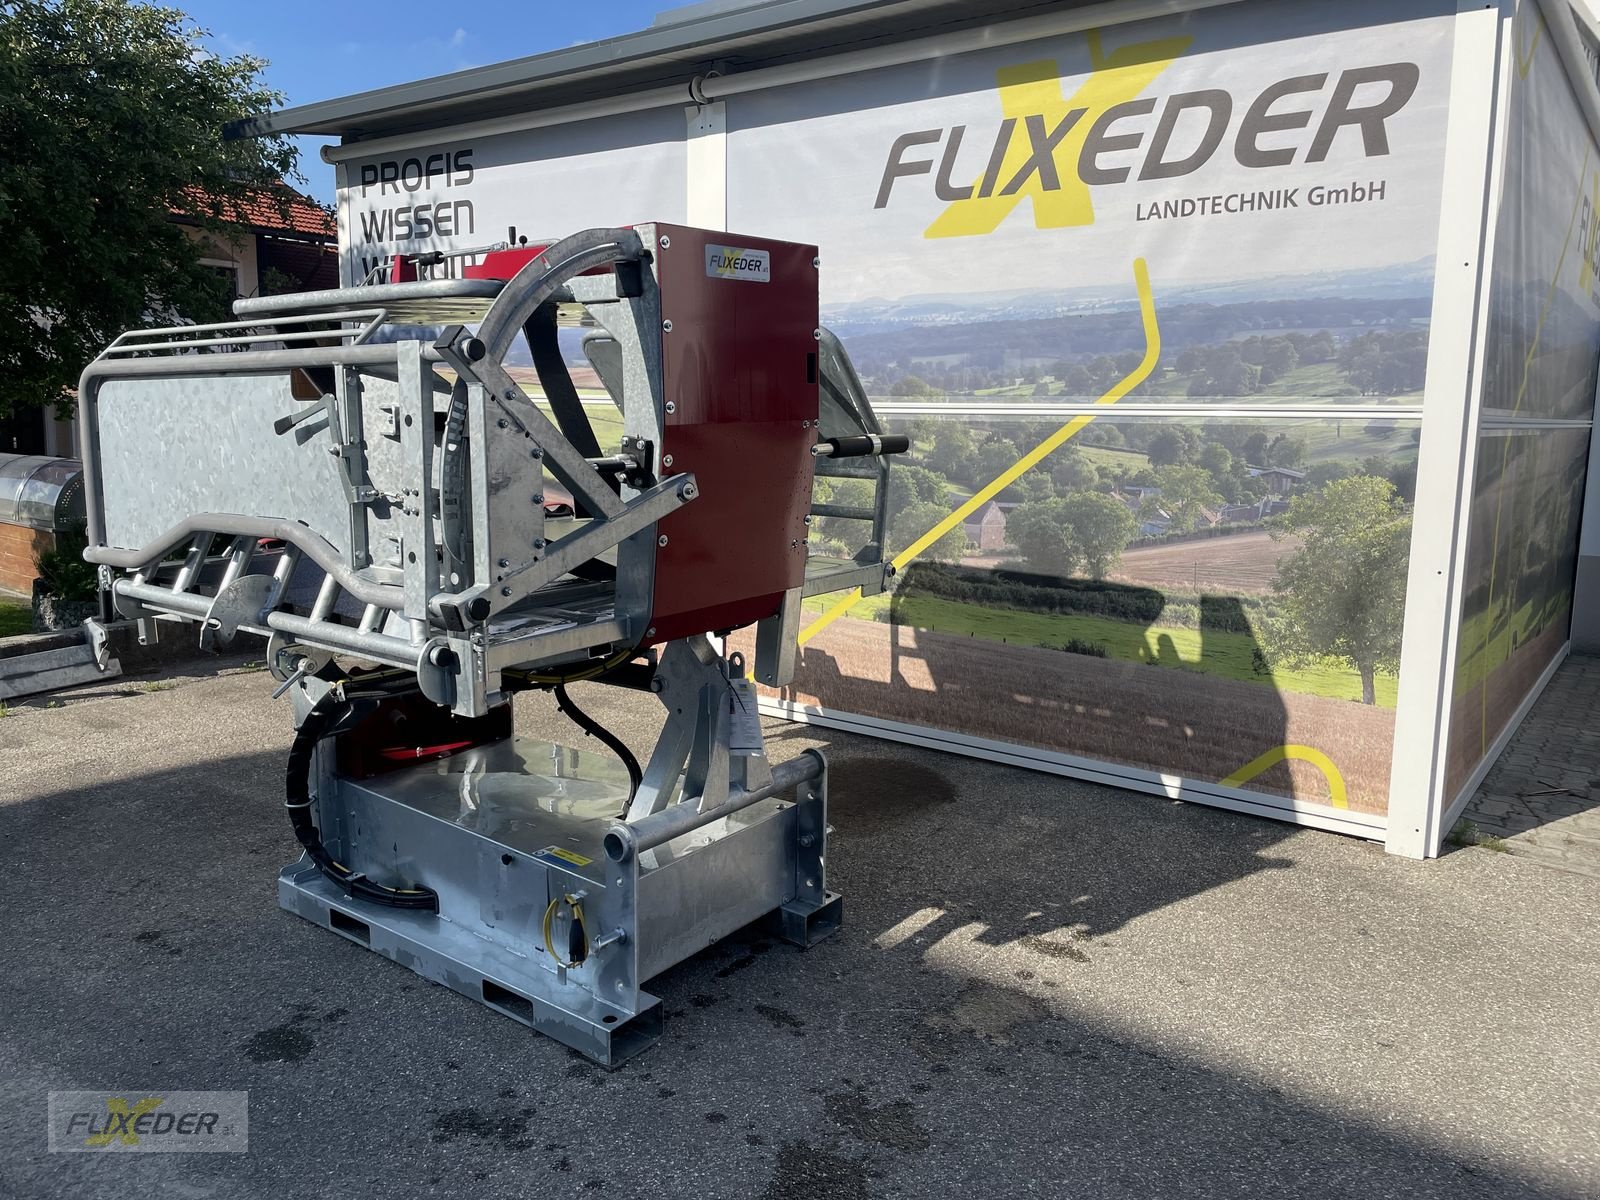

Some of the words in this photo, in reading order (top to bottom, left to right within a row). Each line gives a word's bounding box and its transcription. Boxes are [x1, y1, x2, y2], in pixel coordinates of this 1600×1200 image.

[873, 61, 1420, 209] FLIXEDER
[361, 148, 474, 199] PROFIS
[360, 199, 475, 244] WISSEN
[1136, 187, 1300, 222] LANDTECHNIK
[1307, 180, 1386, 206] GmbH
[709, 254, 762, 272] FLIXEDER
